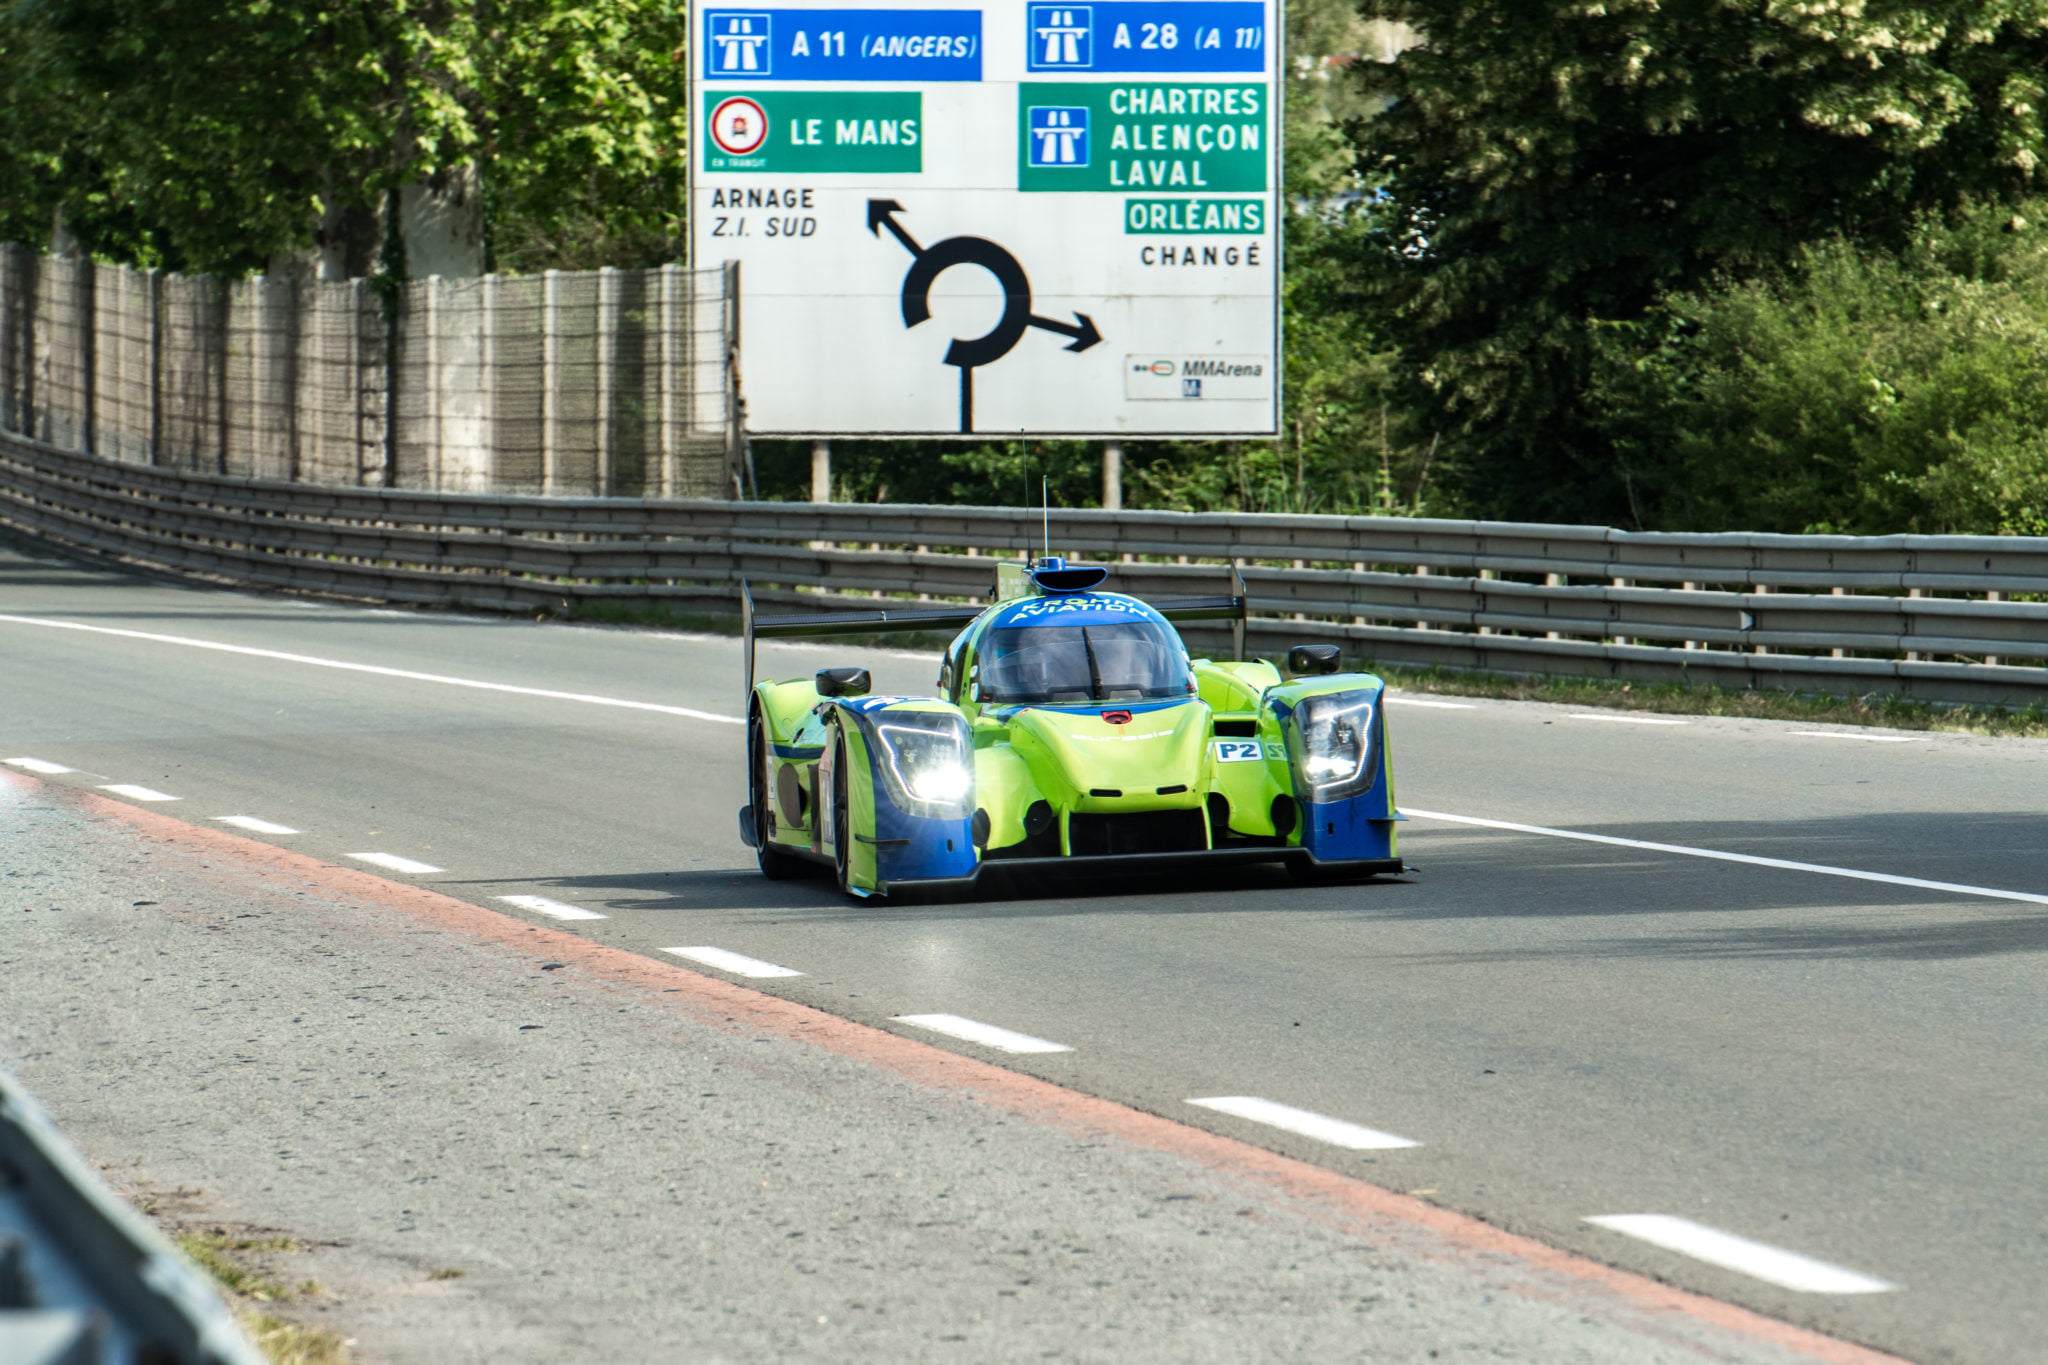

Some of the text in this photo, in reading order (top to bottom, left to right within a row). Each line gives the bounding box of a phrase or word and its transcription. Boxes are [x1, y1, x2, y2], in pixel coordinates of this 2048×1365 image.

[791, 31, 977, 58] A 11 (ANGERS)
[1113, 23, 1262, 50] A 28 (A 11)
[1110, 88, 1259, 115] CHARTRES
[791, 119, 918, 146] LE MANS
[1110, 124, 1259, 153] ALENÇON
[1110, 160, 1207, 186] LAVAL
[712, 188, 815, 209] ARNAGE
[1129, 198, 1261, 230] ORLÉANS
[712, 217, 817, 237] Z.I. SUD
[1141, 242, 1261, 266] CHANGÉ
[1182, 360, 1263, 376] MMArena
[1008, 603, 1149, 624] AVIATION
[1021, 598, 1134, 612] KROHN
[1219, 743, 1258, 759] P2
